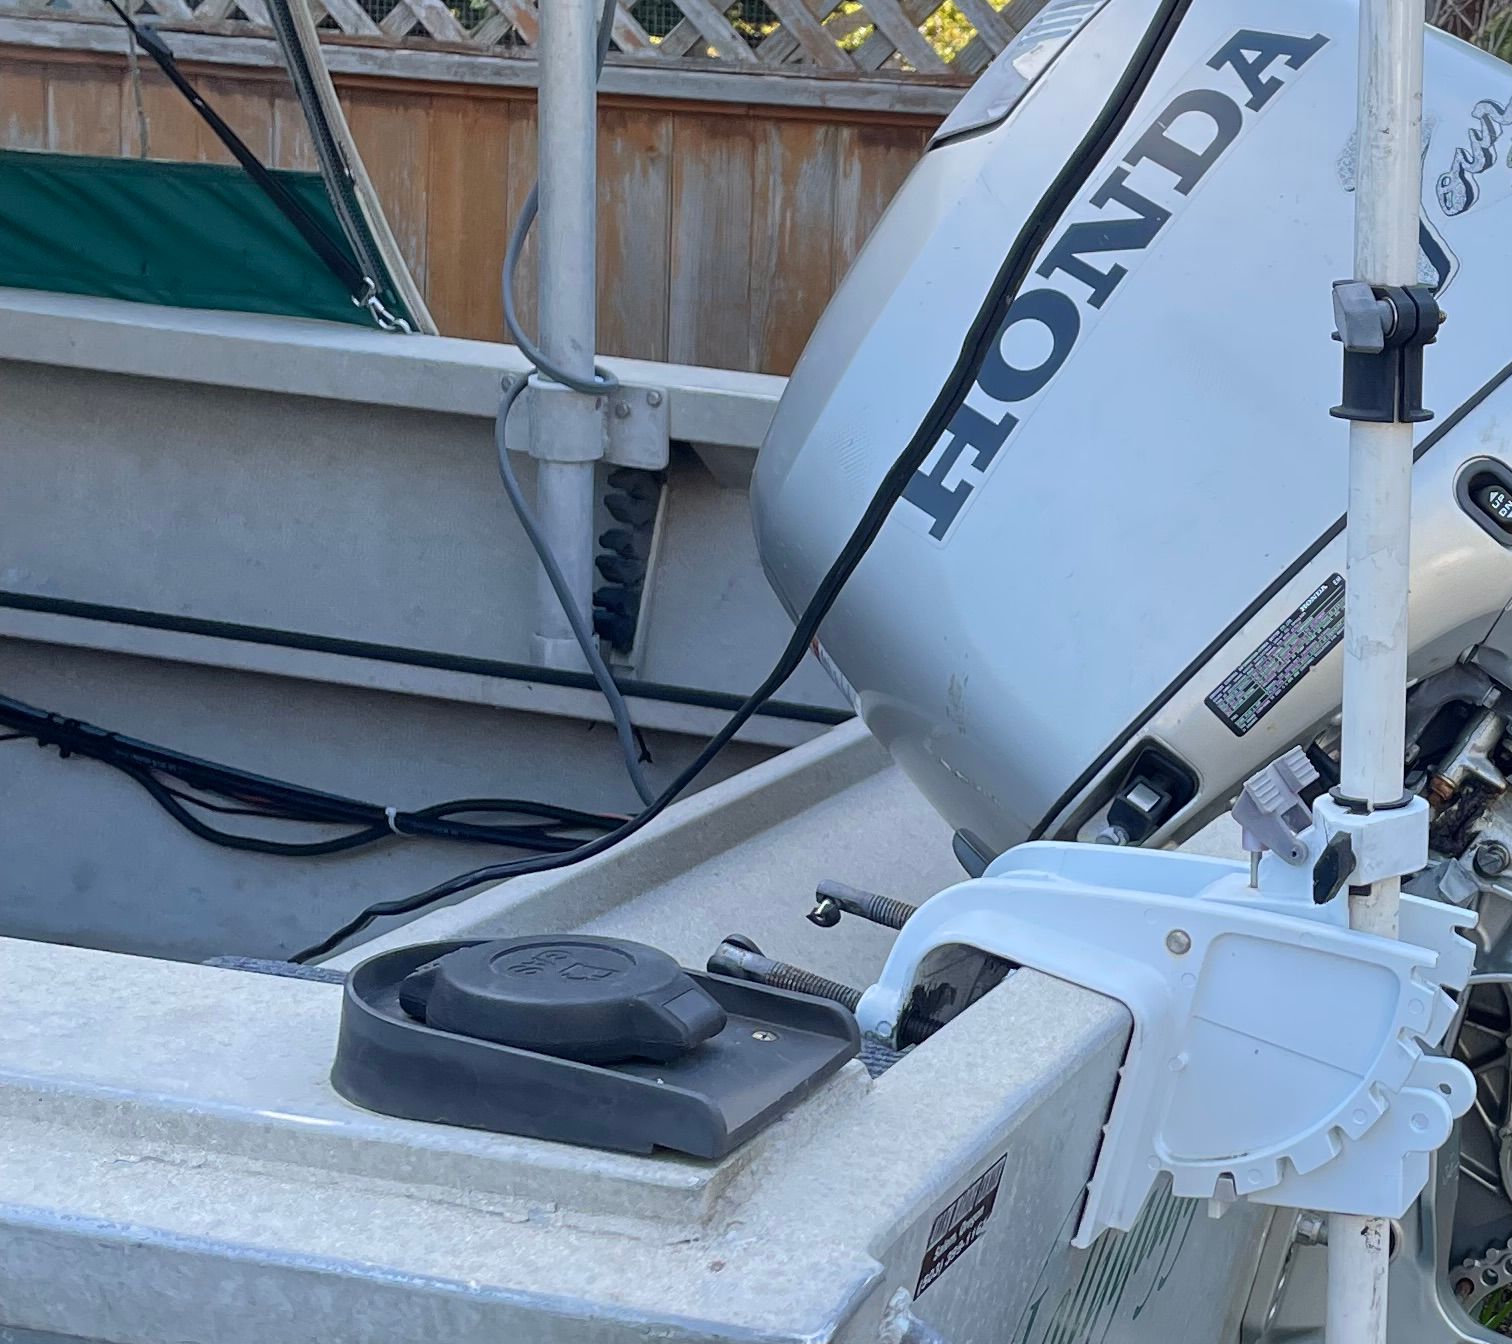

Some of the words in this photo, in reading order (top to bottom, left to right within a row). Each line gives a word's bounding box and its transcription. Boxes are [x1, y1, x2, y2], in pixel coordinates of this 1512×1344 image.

[900, 28, 1332, 543] HONDA
[1491, 494, 1505, 509] UP
[1300, 584, 1328, 612] HONDA
